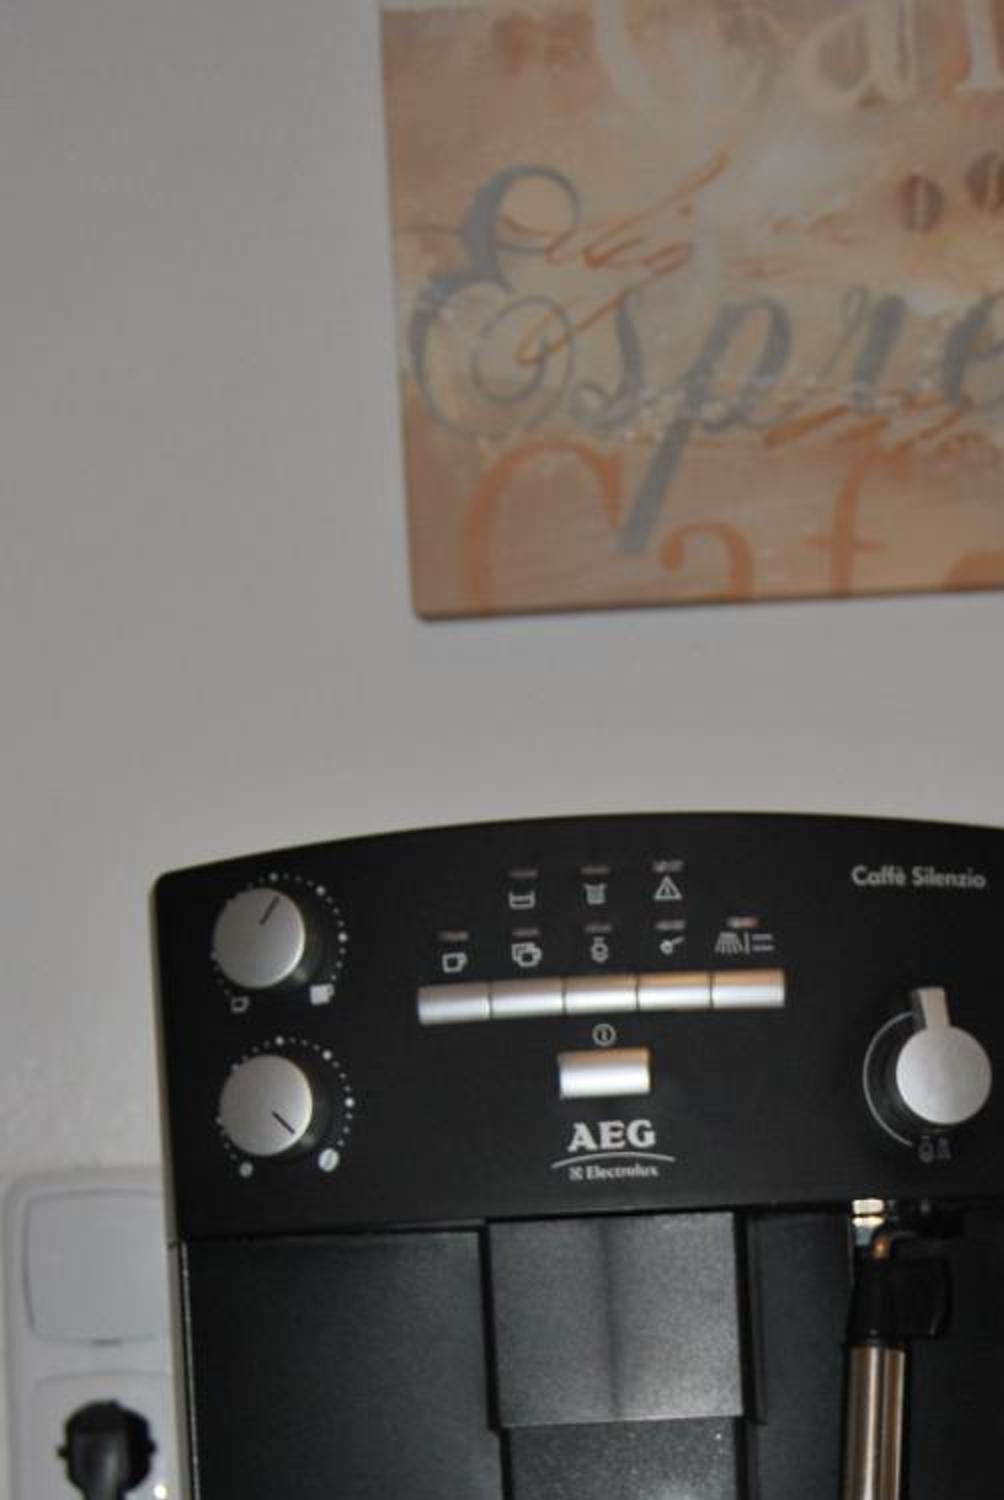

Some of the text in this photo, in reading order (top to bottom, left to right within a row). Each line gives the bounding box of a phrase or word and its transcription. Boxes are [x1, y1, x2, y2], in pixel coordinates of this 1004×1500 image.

[911, 865, 987, 889] Silenzio
[567, 1119, 656, 1152] AEG
[586, 1164, 658, 1180] Electrolux
